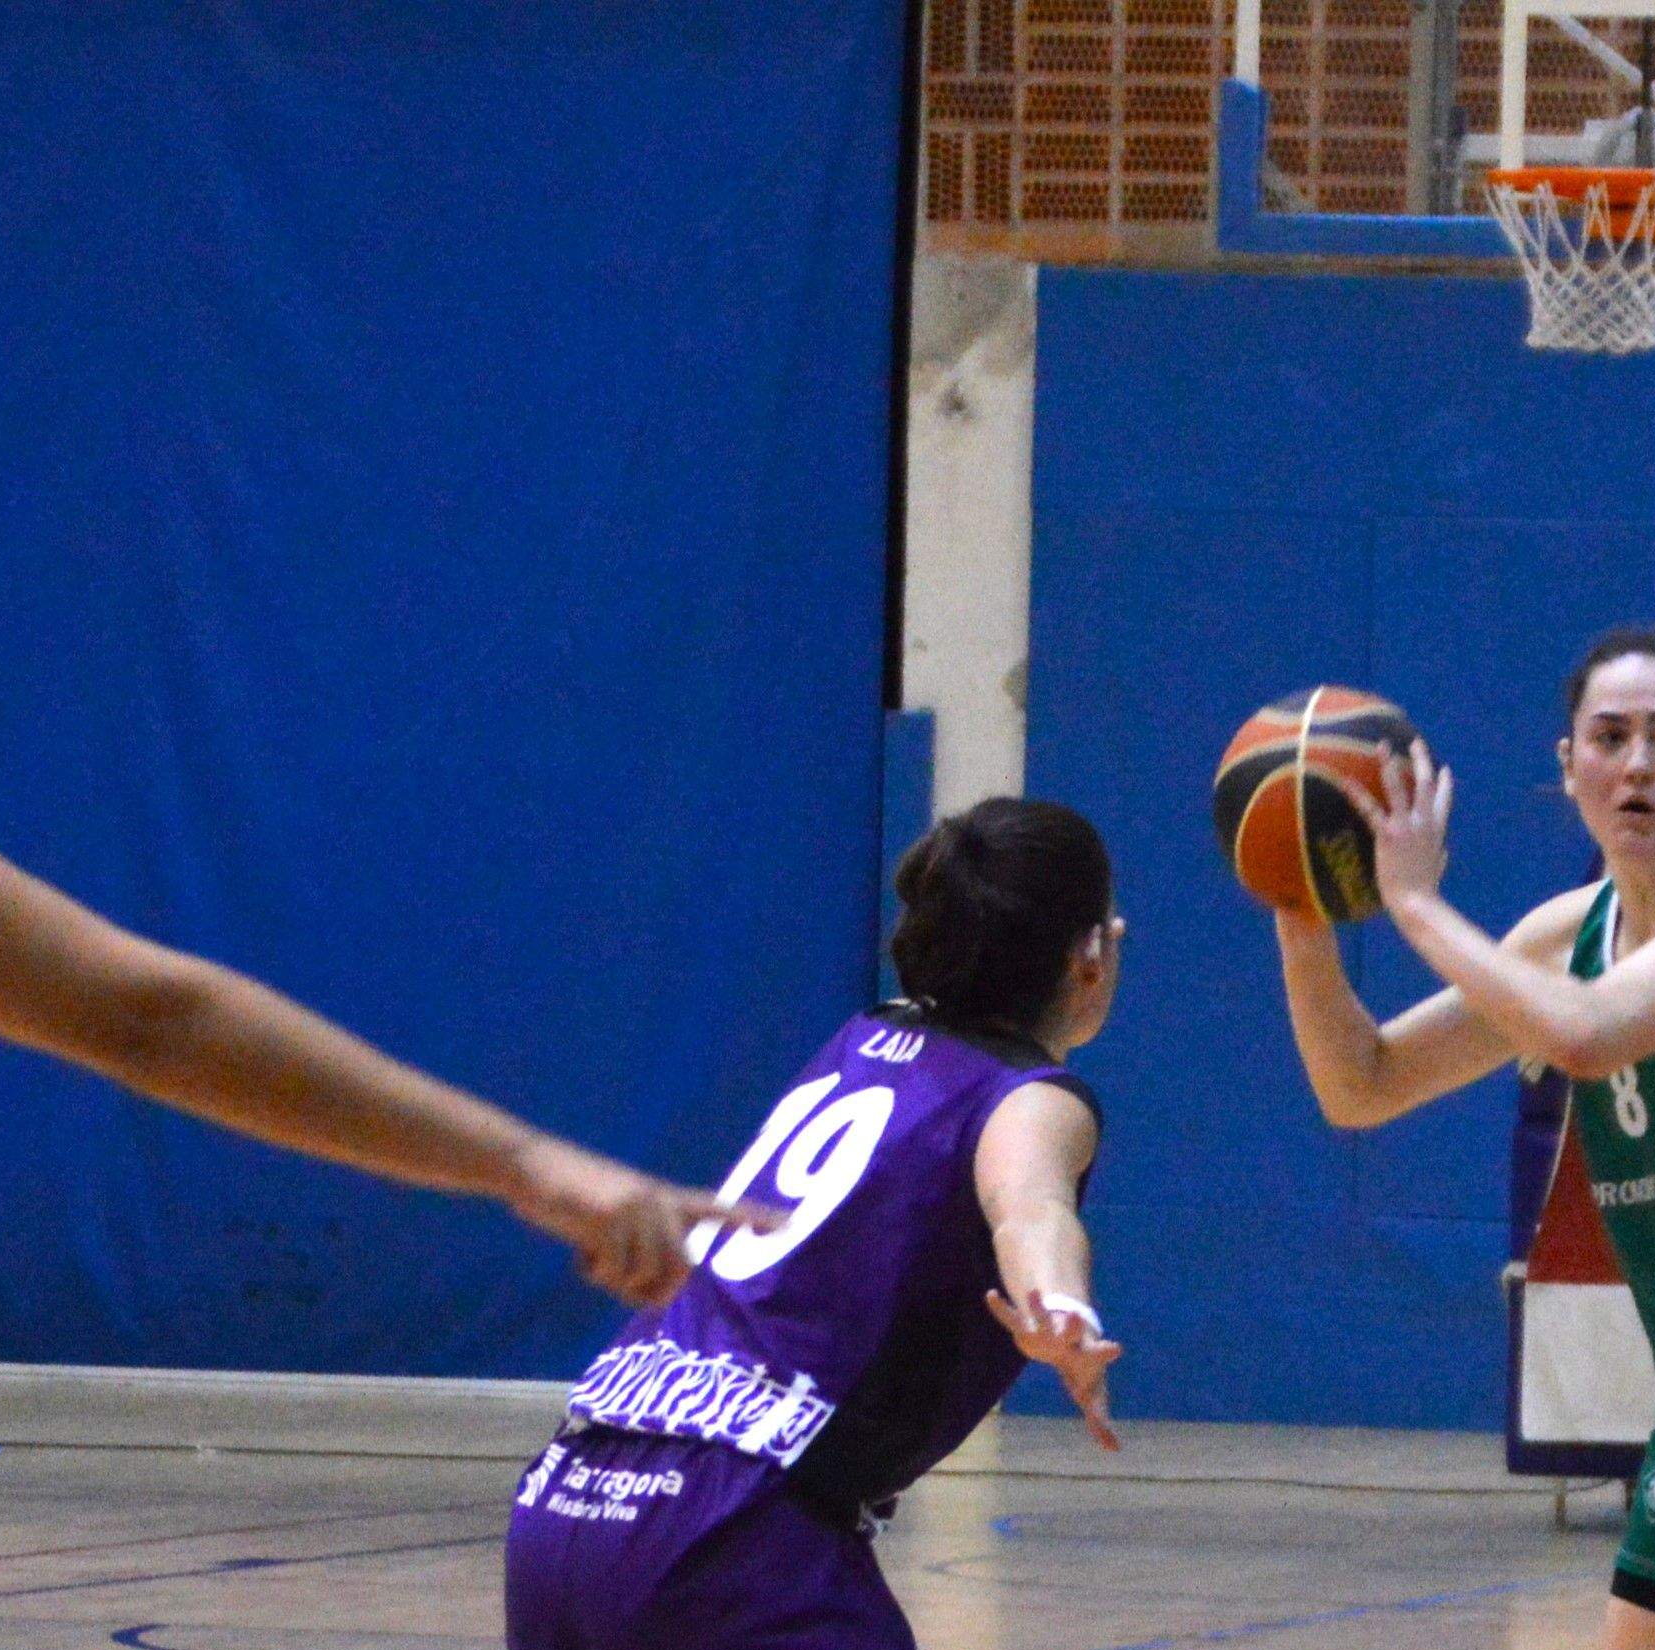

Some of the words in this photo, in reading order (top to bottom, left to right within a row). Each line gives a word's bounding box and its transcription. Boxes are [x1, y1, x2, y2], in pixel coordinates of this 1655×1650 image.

[857, 1028, 926, 1063] LAIA
[1608, 1063, 1649, 1138] 8
[685, 1071, 895, 1282] 19
